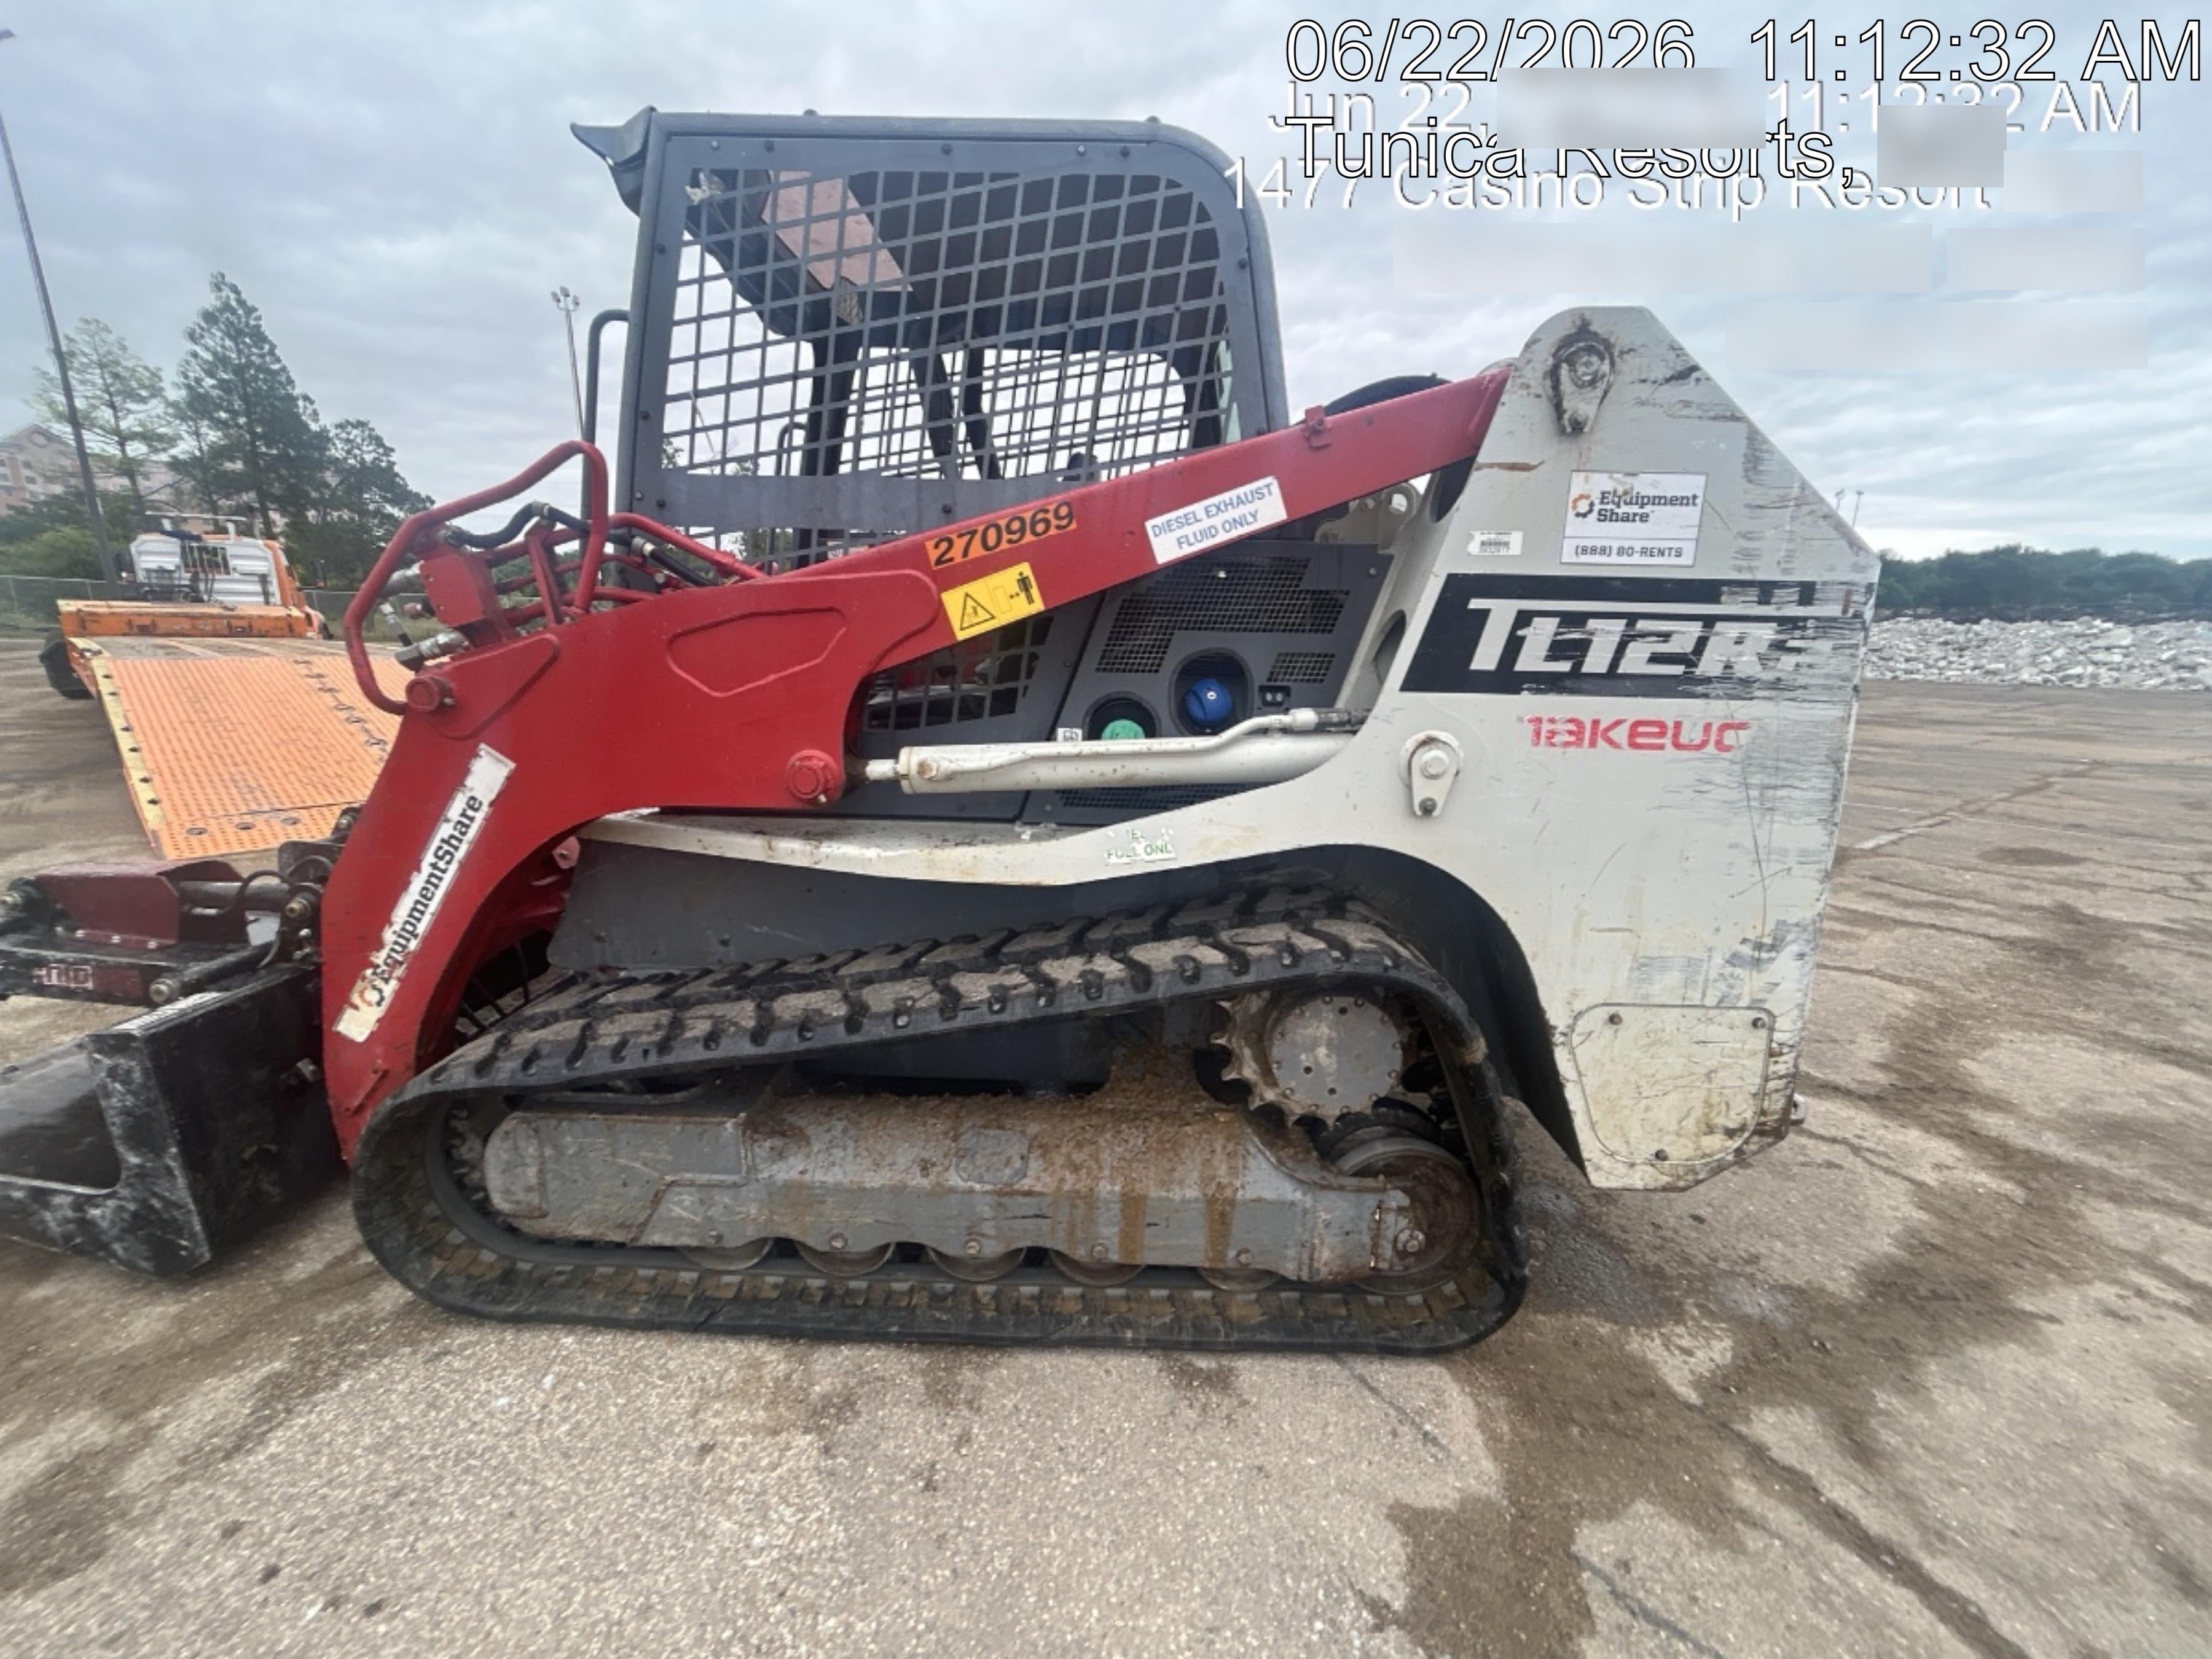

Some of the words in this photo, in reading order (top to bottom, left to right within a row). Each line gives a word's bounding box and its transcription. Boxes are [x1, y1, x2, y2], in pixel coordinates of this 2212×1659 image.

[1151, 511, 1202, 538] DIESEL
[1204, 483, 1274, 519] EXHAUST
[1597, 509, 1650, 523] Share
[1599, 490, 1698, 509] Equipment
[933, 501, 1073, 566] 270969
[1176, 525, 1219, 549] FLUID
[1222, 509, 1259, 533] ONLY
[1575, 545, 1612, 557] (888)
[1616, 546, 1683, 557] 80-RENTS
[372, 794, 484, 984] EquipmentShare
